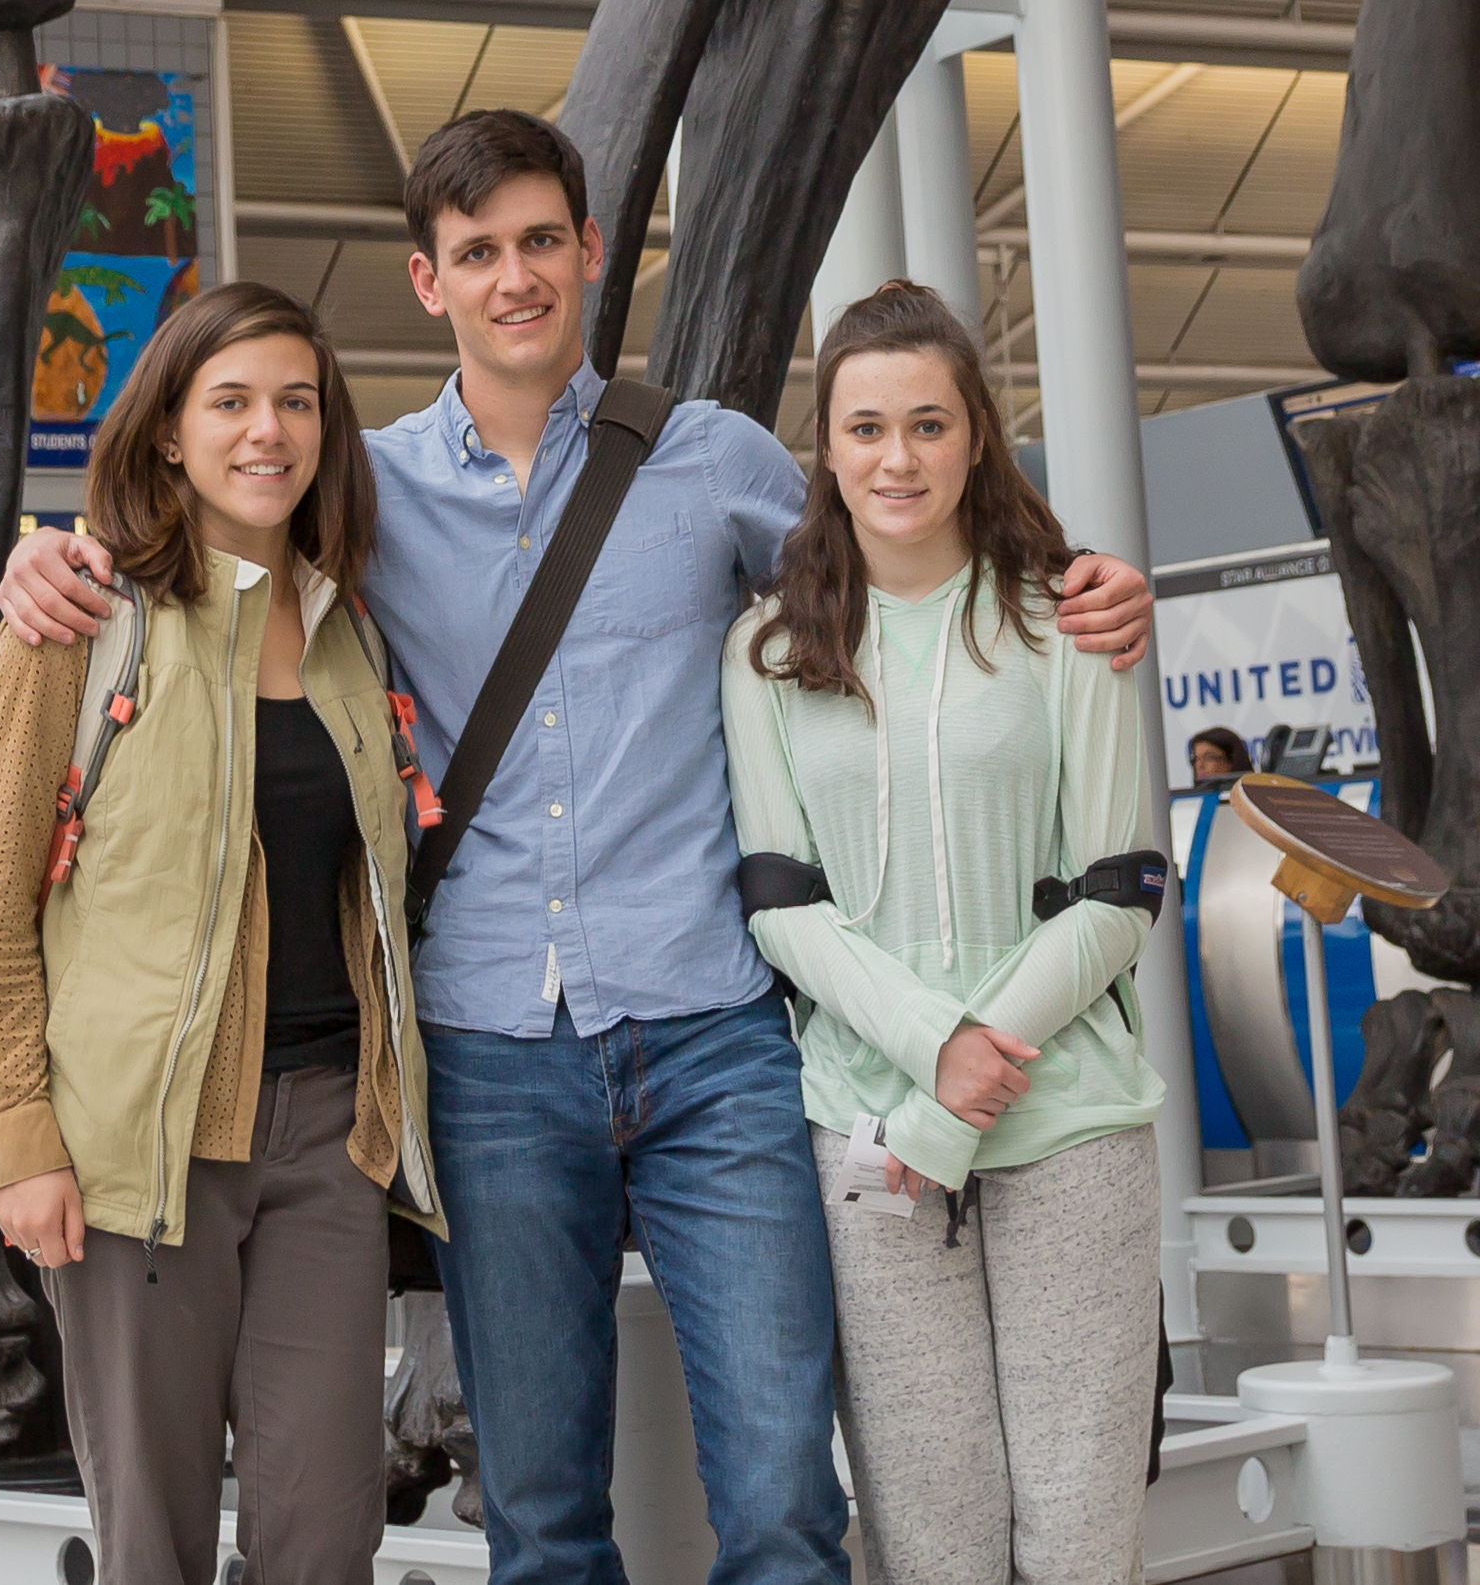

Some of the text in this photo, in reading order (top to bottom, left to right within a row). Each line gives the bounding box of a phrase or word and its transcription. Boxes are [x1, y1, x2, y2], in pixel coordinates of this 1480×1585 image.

[31, 433, 87, 450] STUDENTS
[1221, 558, 1314, 587] STAR ALLIANCE
[1166, 657, 1337, 709] UNITED
